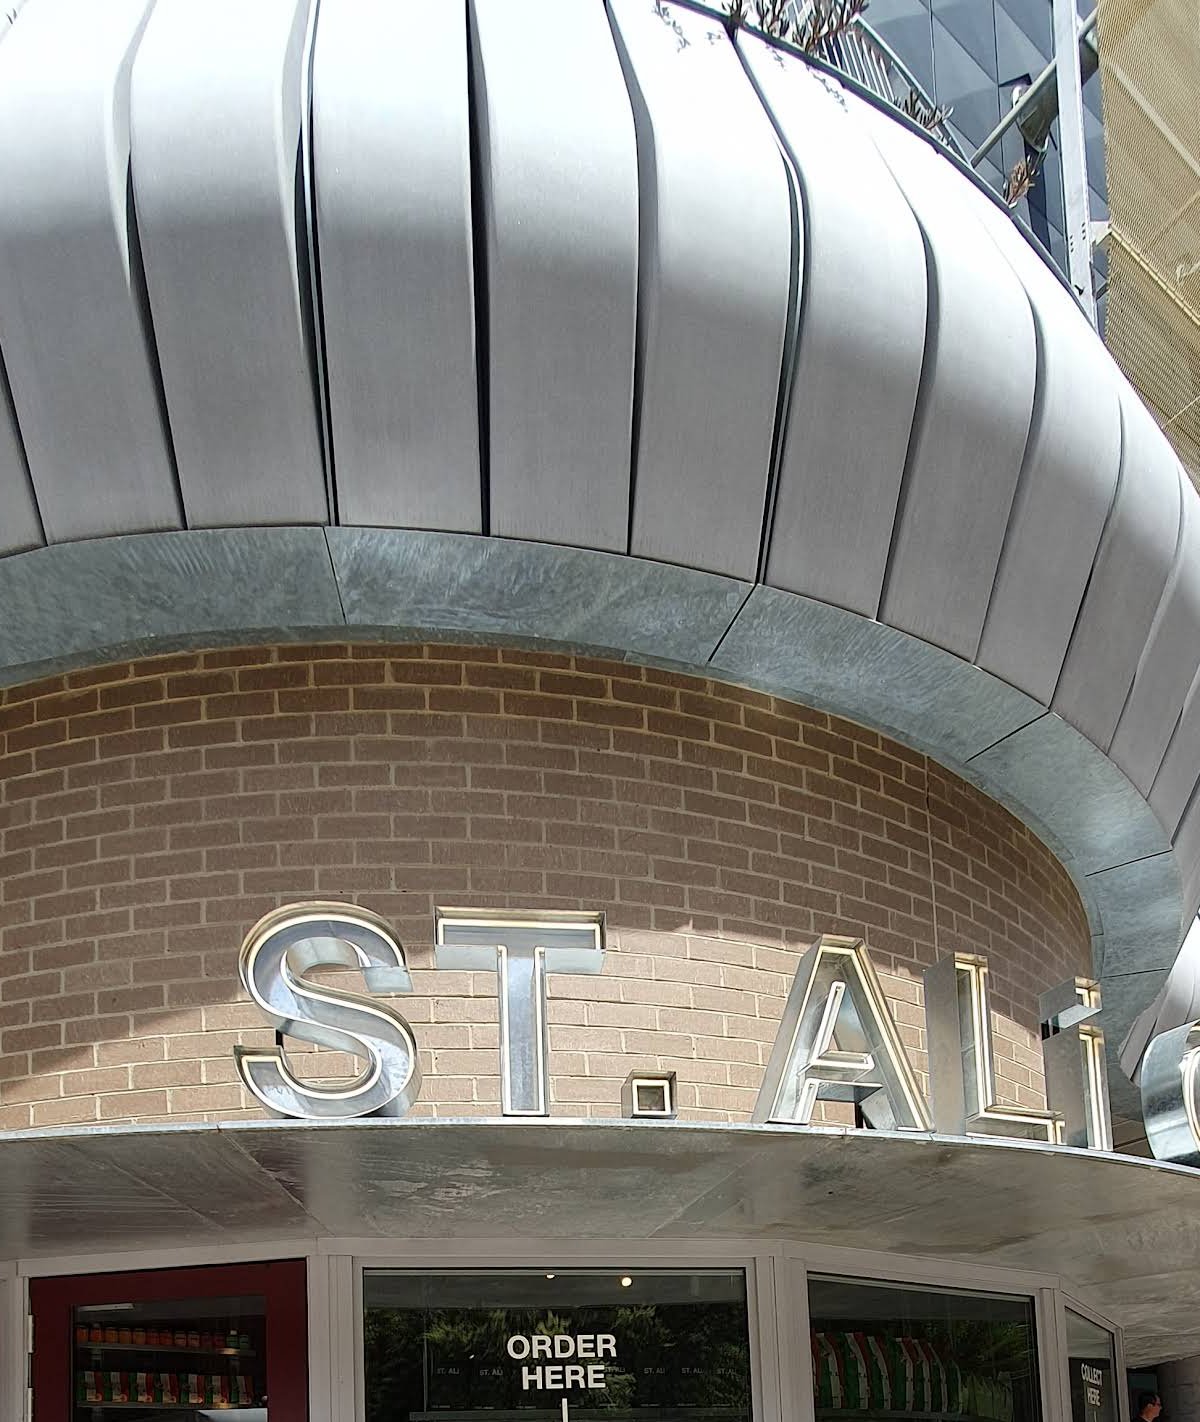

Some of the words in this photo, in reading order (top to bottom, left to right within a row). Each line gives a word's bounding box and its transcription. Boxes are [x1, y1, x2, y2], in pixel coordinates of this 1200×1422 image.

[233, 900, 677, 1120] ST.
[506, 1333, 618, 1361] ORDER
[521, 1364, 607, 1391] HERE
[1080, 1362, 1103, 1386] COLLECT
[1087, 1387, 1101, 1407] HERE
